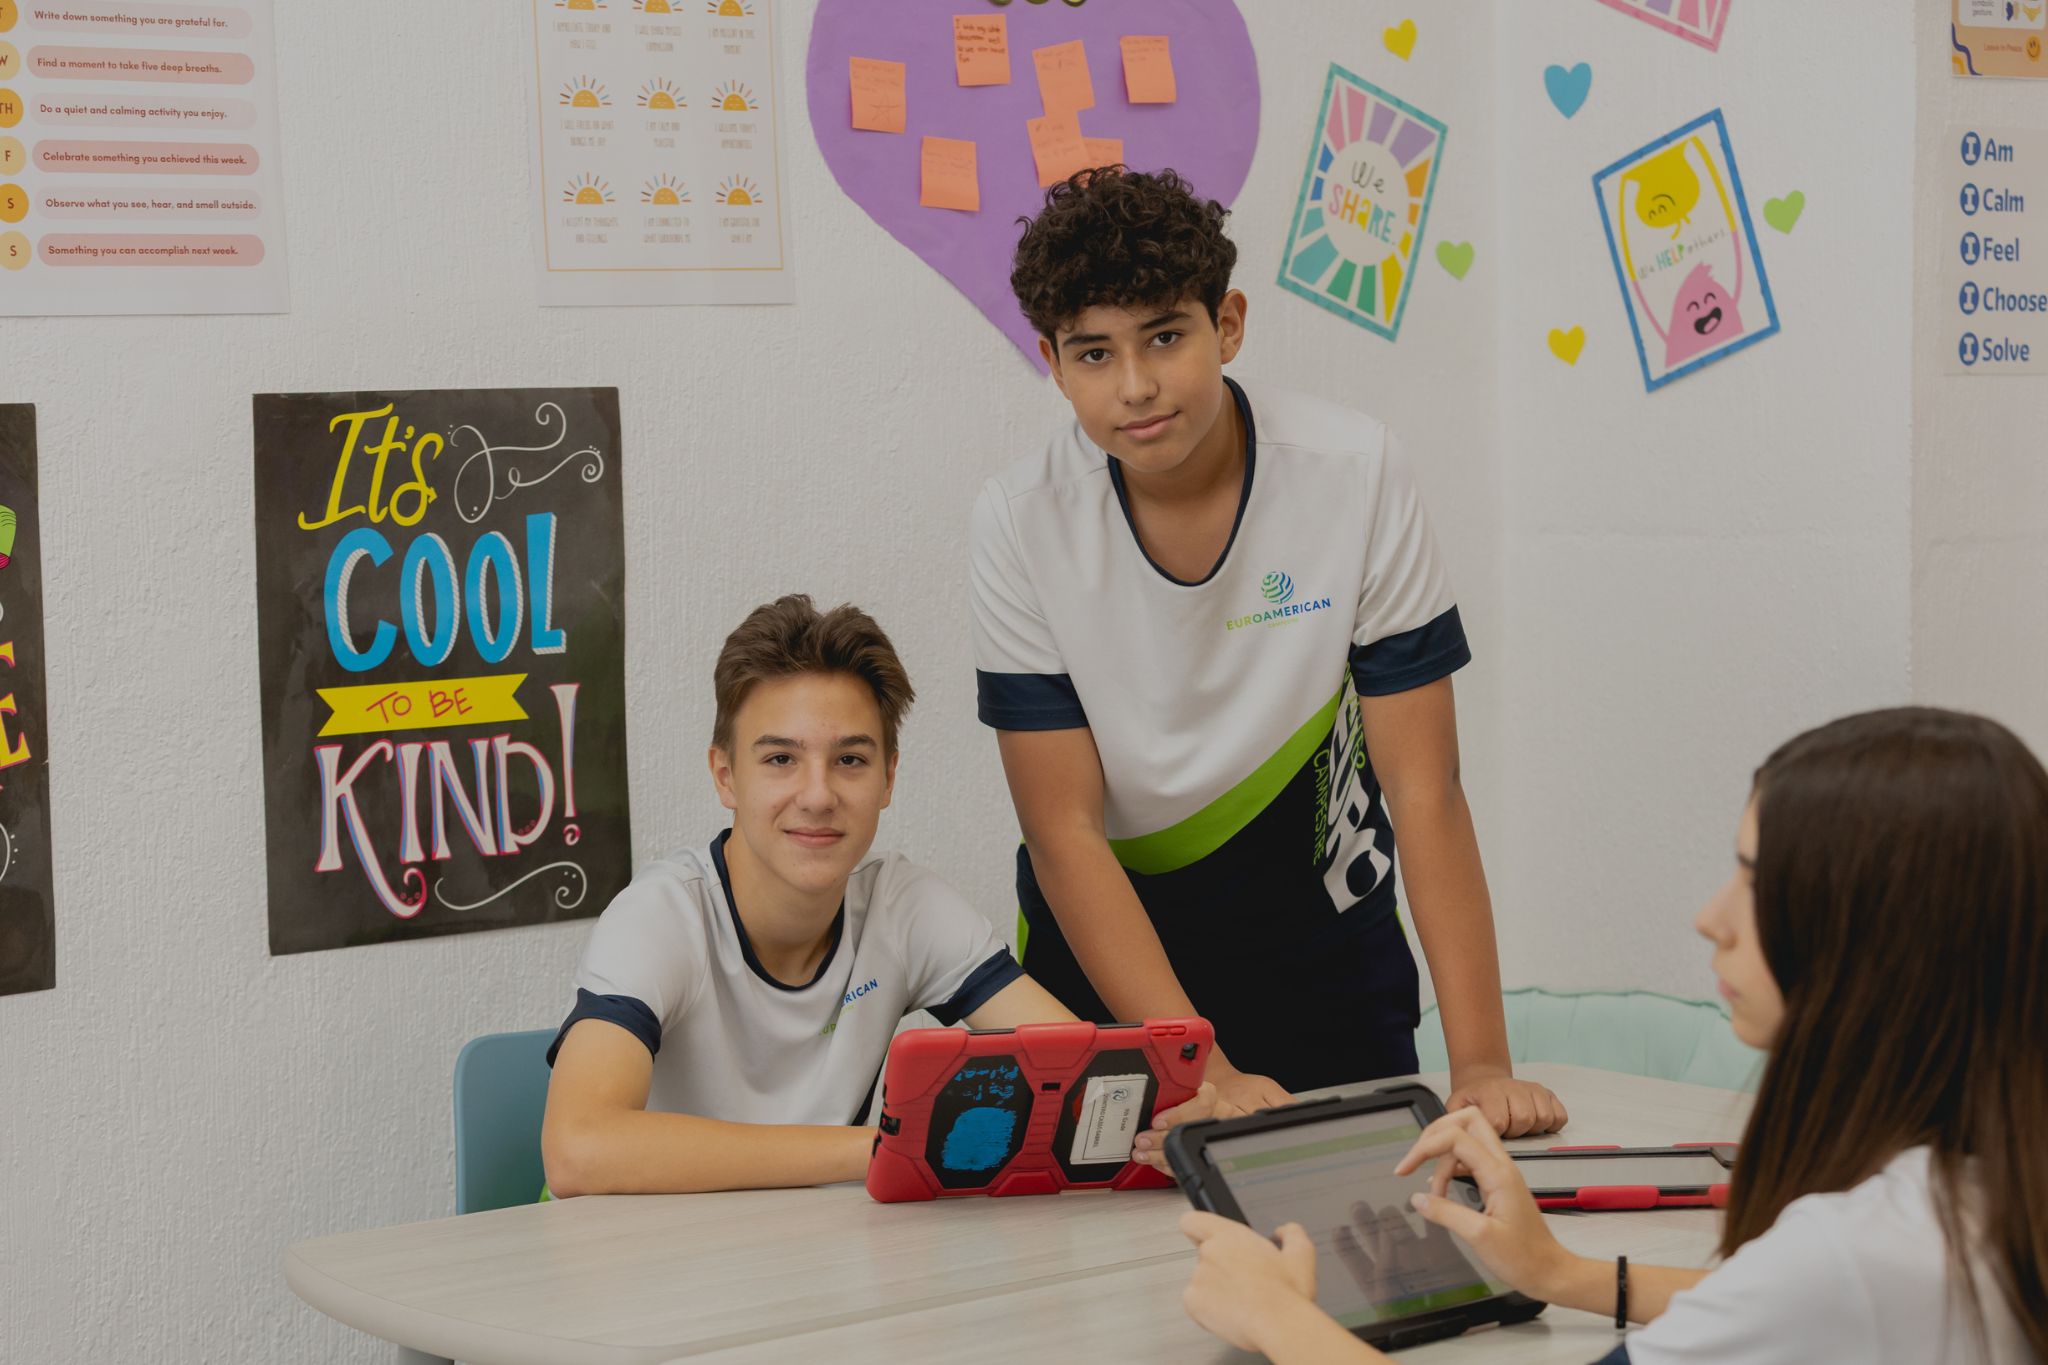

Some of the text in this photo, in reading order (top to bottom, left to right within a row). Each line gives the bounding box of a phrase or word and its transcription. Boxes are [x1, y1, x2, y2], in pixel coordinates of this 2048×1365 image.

[34, 11, 60, 20] Write
[62, 11, 88, 21] down
[90, 12, 137, 26] something
[139, 17, 156, 26] you
[175, 17, 211, 28] grateful
[213, 19, 228, 27] for.
[37, 58, 58, 67] Find
[68, 60, 105, 69] moment
[108, 61, 117, 69] to
[119, 61, 139, 70] take
[141, 61, 158, 70] five
[160, 62, 183, 73] deep
[185, 62, 222, 73] breaths.
[40, 104, 53, 113] Do
[64, 106, 87, 115] quiet
[90, 105, 107, 114] and
[110, 107, 146, 117] calming
[149, 108, 181, 118] activity
[183, 110, 199, 119] you
[201, 109, 227, 120] enjoy.
[5, 150, 11, 161] F
[43, 151, 247, 165] Celebrate something you achieved this week.
[1984, 138, 2013, 162] Am
[1352, 160, 1384, 194] We
[7, 198, 15, 209] S
[46, 199, 257, 210] Observe what you see, hear, and smell outside.
[1983, 188, 2024, 212] Calm
[10, 245, 17, 257] S
[48, 245, 98, 257] Something
[100, 248, 117, 257] you
[138, 246, 189, 257] accomplish
[213, 246, 238, 255] week.
[1655, 243, 1685, 270] HELP
[1983, 237, 2020, 262] Feel
[1983, 287, 2048, 312] Choose
[1982, 337, 2029, 362] Solve
[298, 402, 444, 530] It's
[324, 511, 567, 672] COOL
[1226, 598, 1331, 631] EUROAMERICAN
[366, 687, 473, 725] TO BE
[313, 682, 581, 919] KIND!
